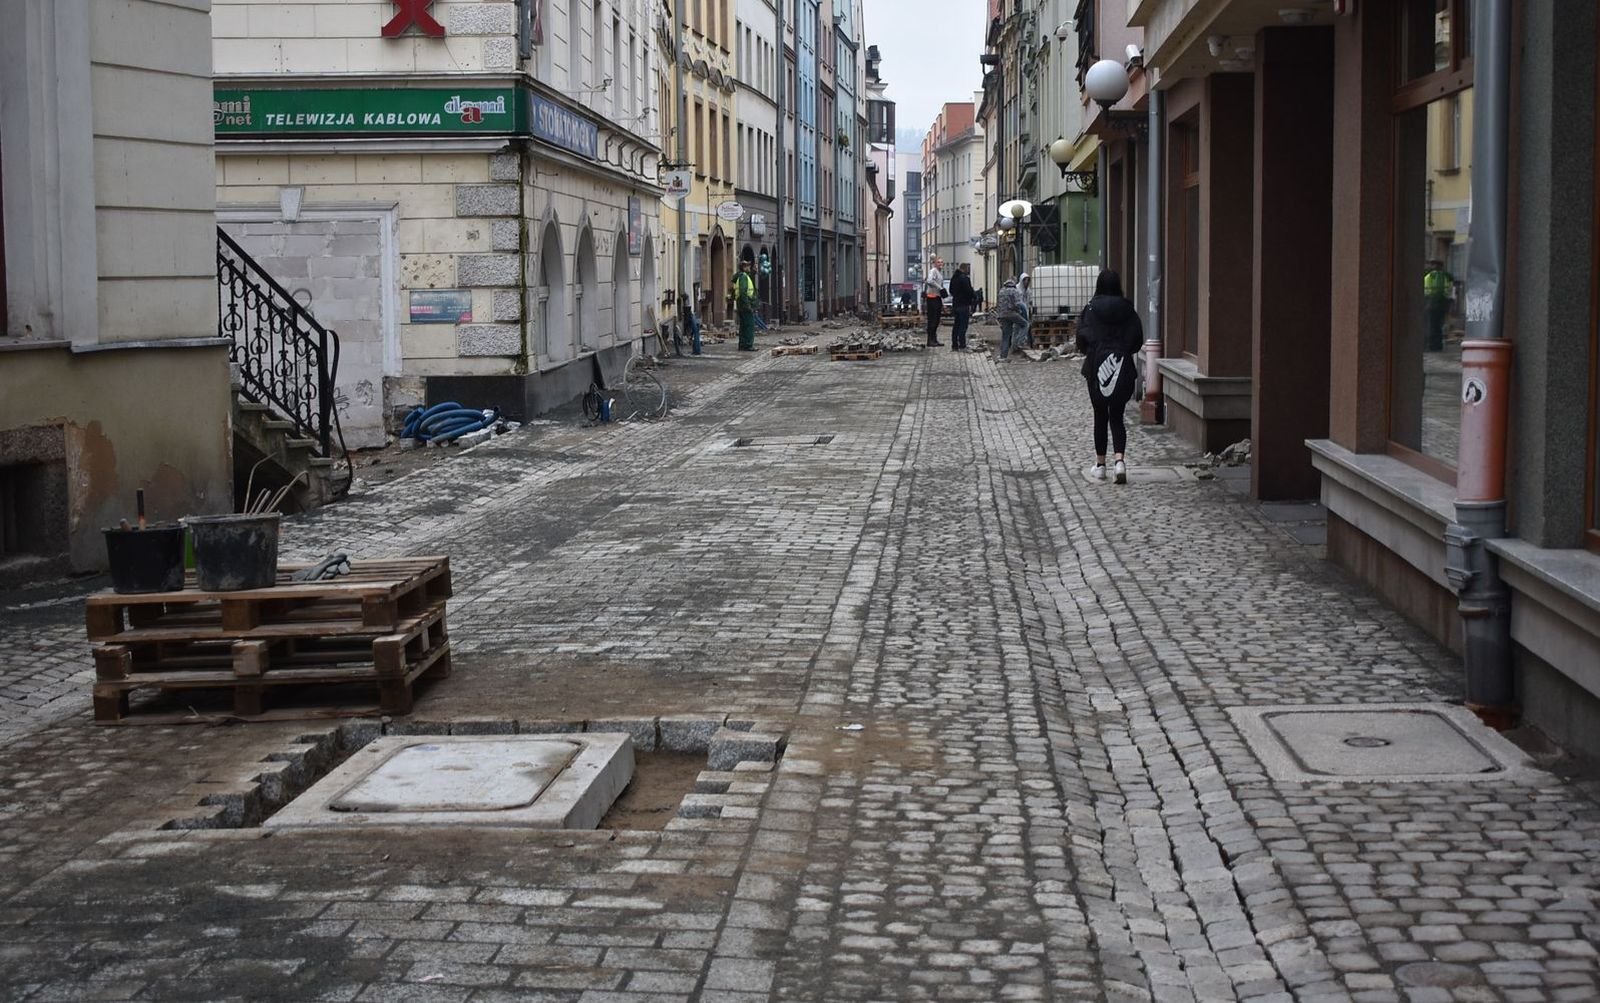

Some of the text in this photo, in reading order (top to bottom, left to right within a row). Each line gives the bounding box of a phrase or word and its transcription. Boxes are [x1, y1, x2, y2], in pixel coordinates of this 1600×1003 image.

[265, 113, 442, 125] TELEWIZJA KABLOWA
[1097, 353, 1118, 385] NIKE
